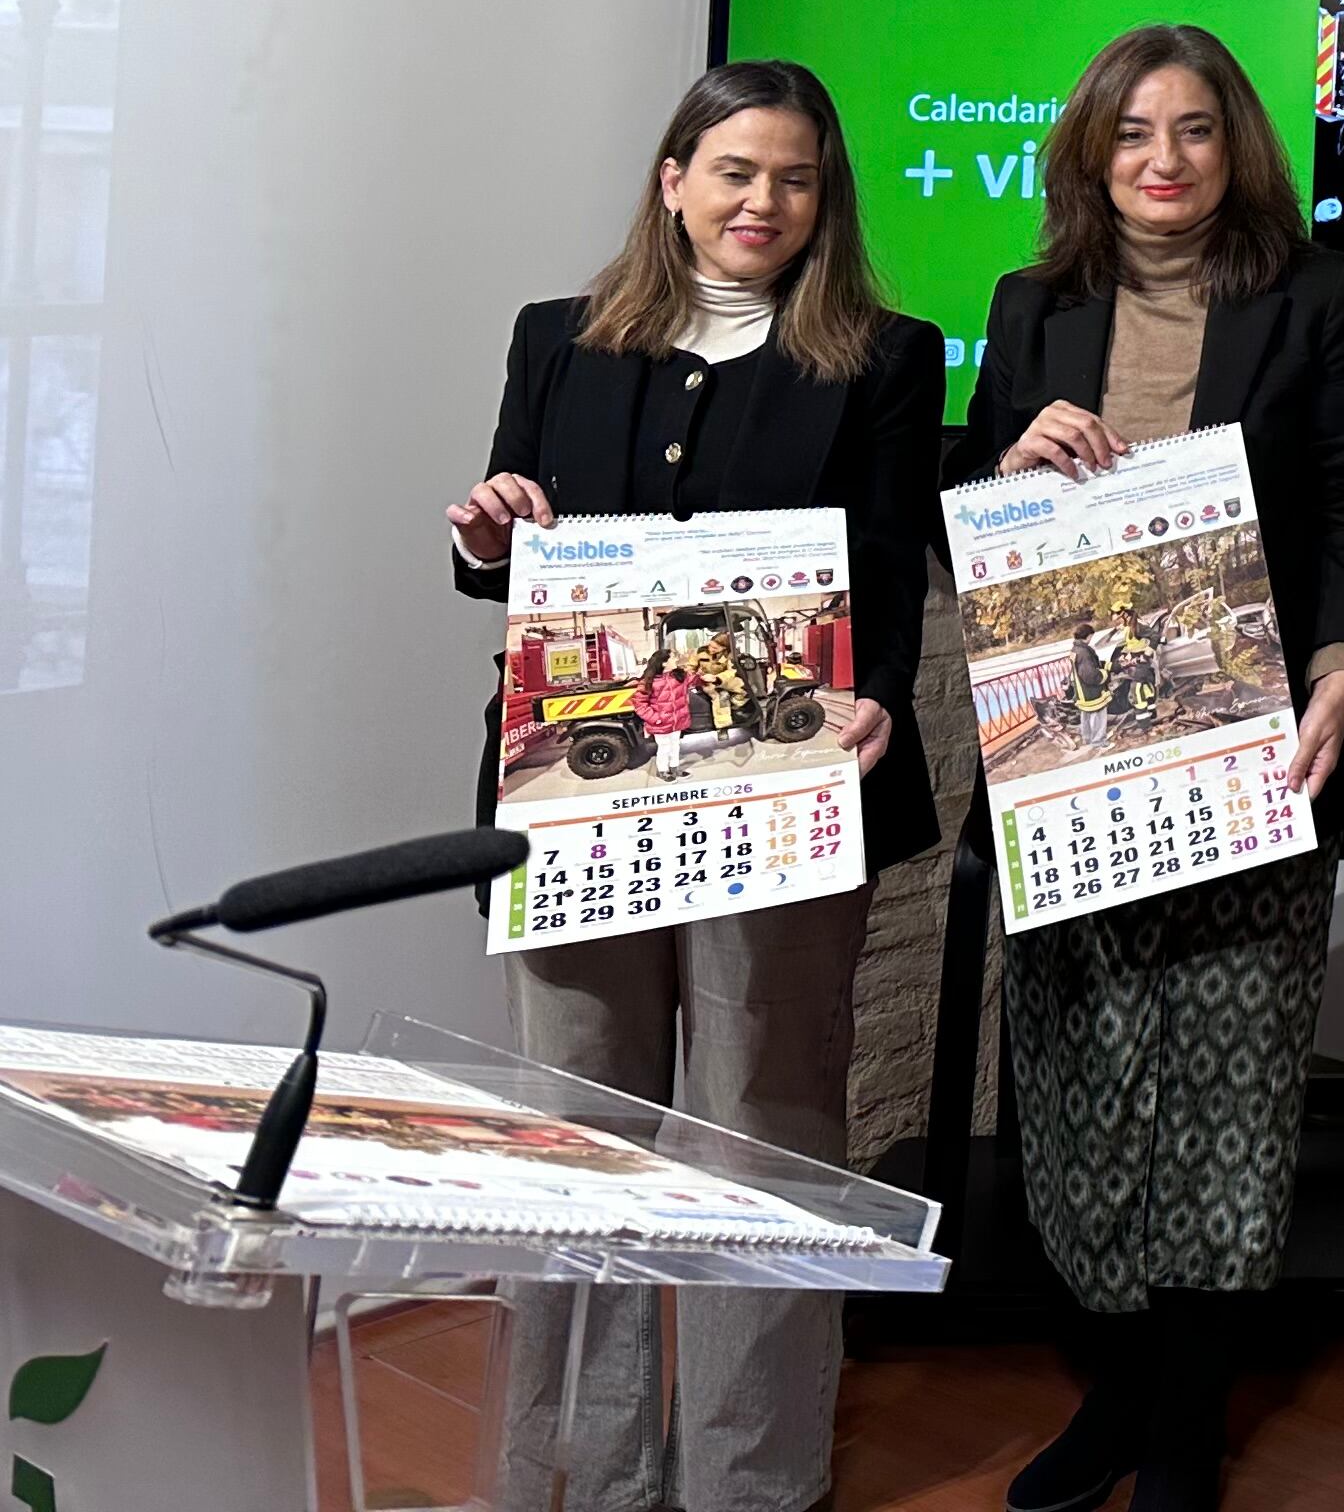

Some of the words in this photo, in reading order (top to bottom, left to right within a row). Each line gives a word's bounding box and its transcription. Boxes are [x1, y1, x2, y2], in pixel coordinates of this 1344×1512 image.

[909, 93, 1067, 124] Calendari
[976, 140, 1046, 199] vi
[554, 655, 578, 666] 112
[1104, 756, 1143, 775] MAYO
[1146, 746, 1182, 765] 2026
[612, 788, 708, 810] SEPTIEMBRE
[713, 783, 753, 798] 2026
[534, 870, 568, 888] 14
[582, 863, 615, 881] 15
[629, 856, 662, 874] 16
[676, 849, 707, 867] 17
[720, 842, 753, 859] 18
[767, 833, 797, 850] 19
[809, 823, 841, 842] 20
[1030, 867, 1060, 887] 18
[1070, 857, 1099, 877] 19
[1109, 846, 1139, 868] 20
[1148, 836, 1175, 857] 21
[1187, 826, 1217, 847] 22
[1226, 816, 1255, 836] 23
[1264, 804, 1294, 825] 24
